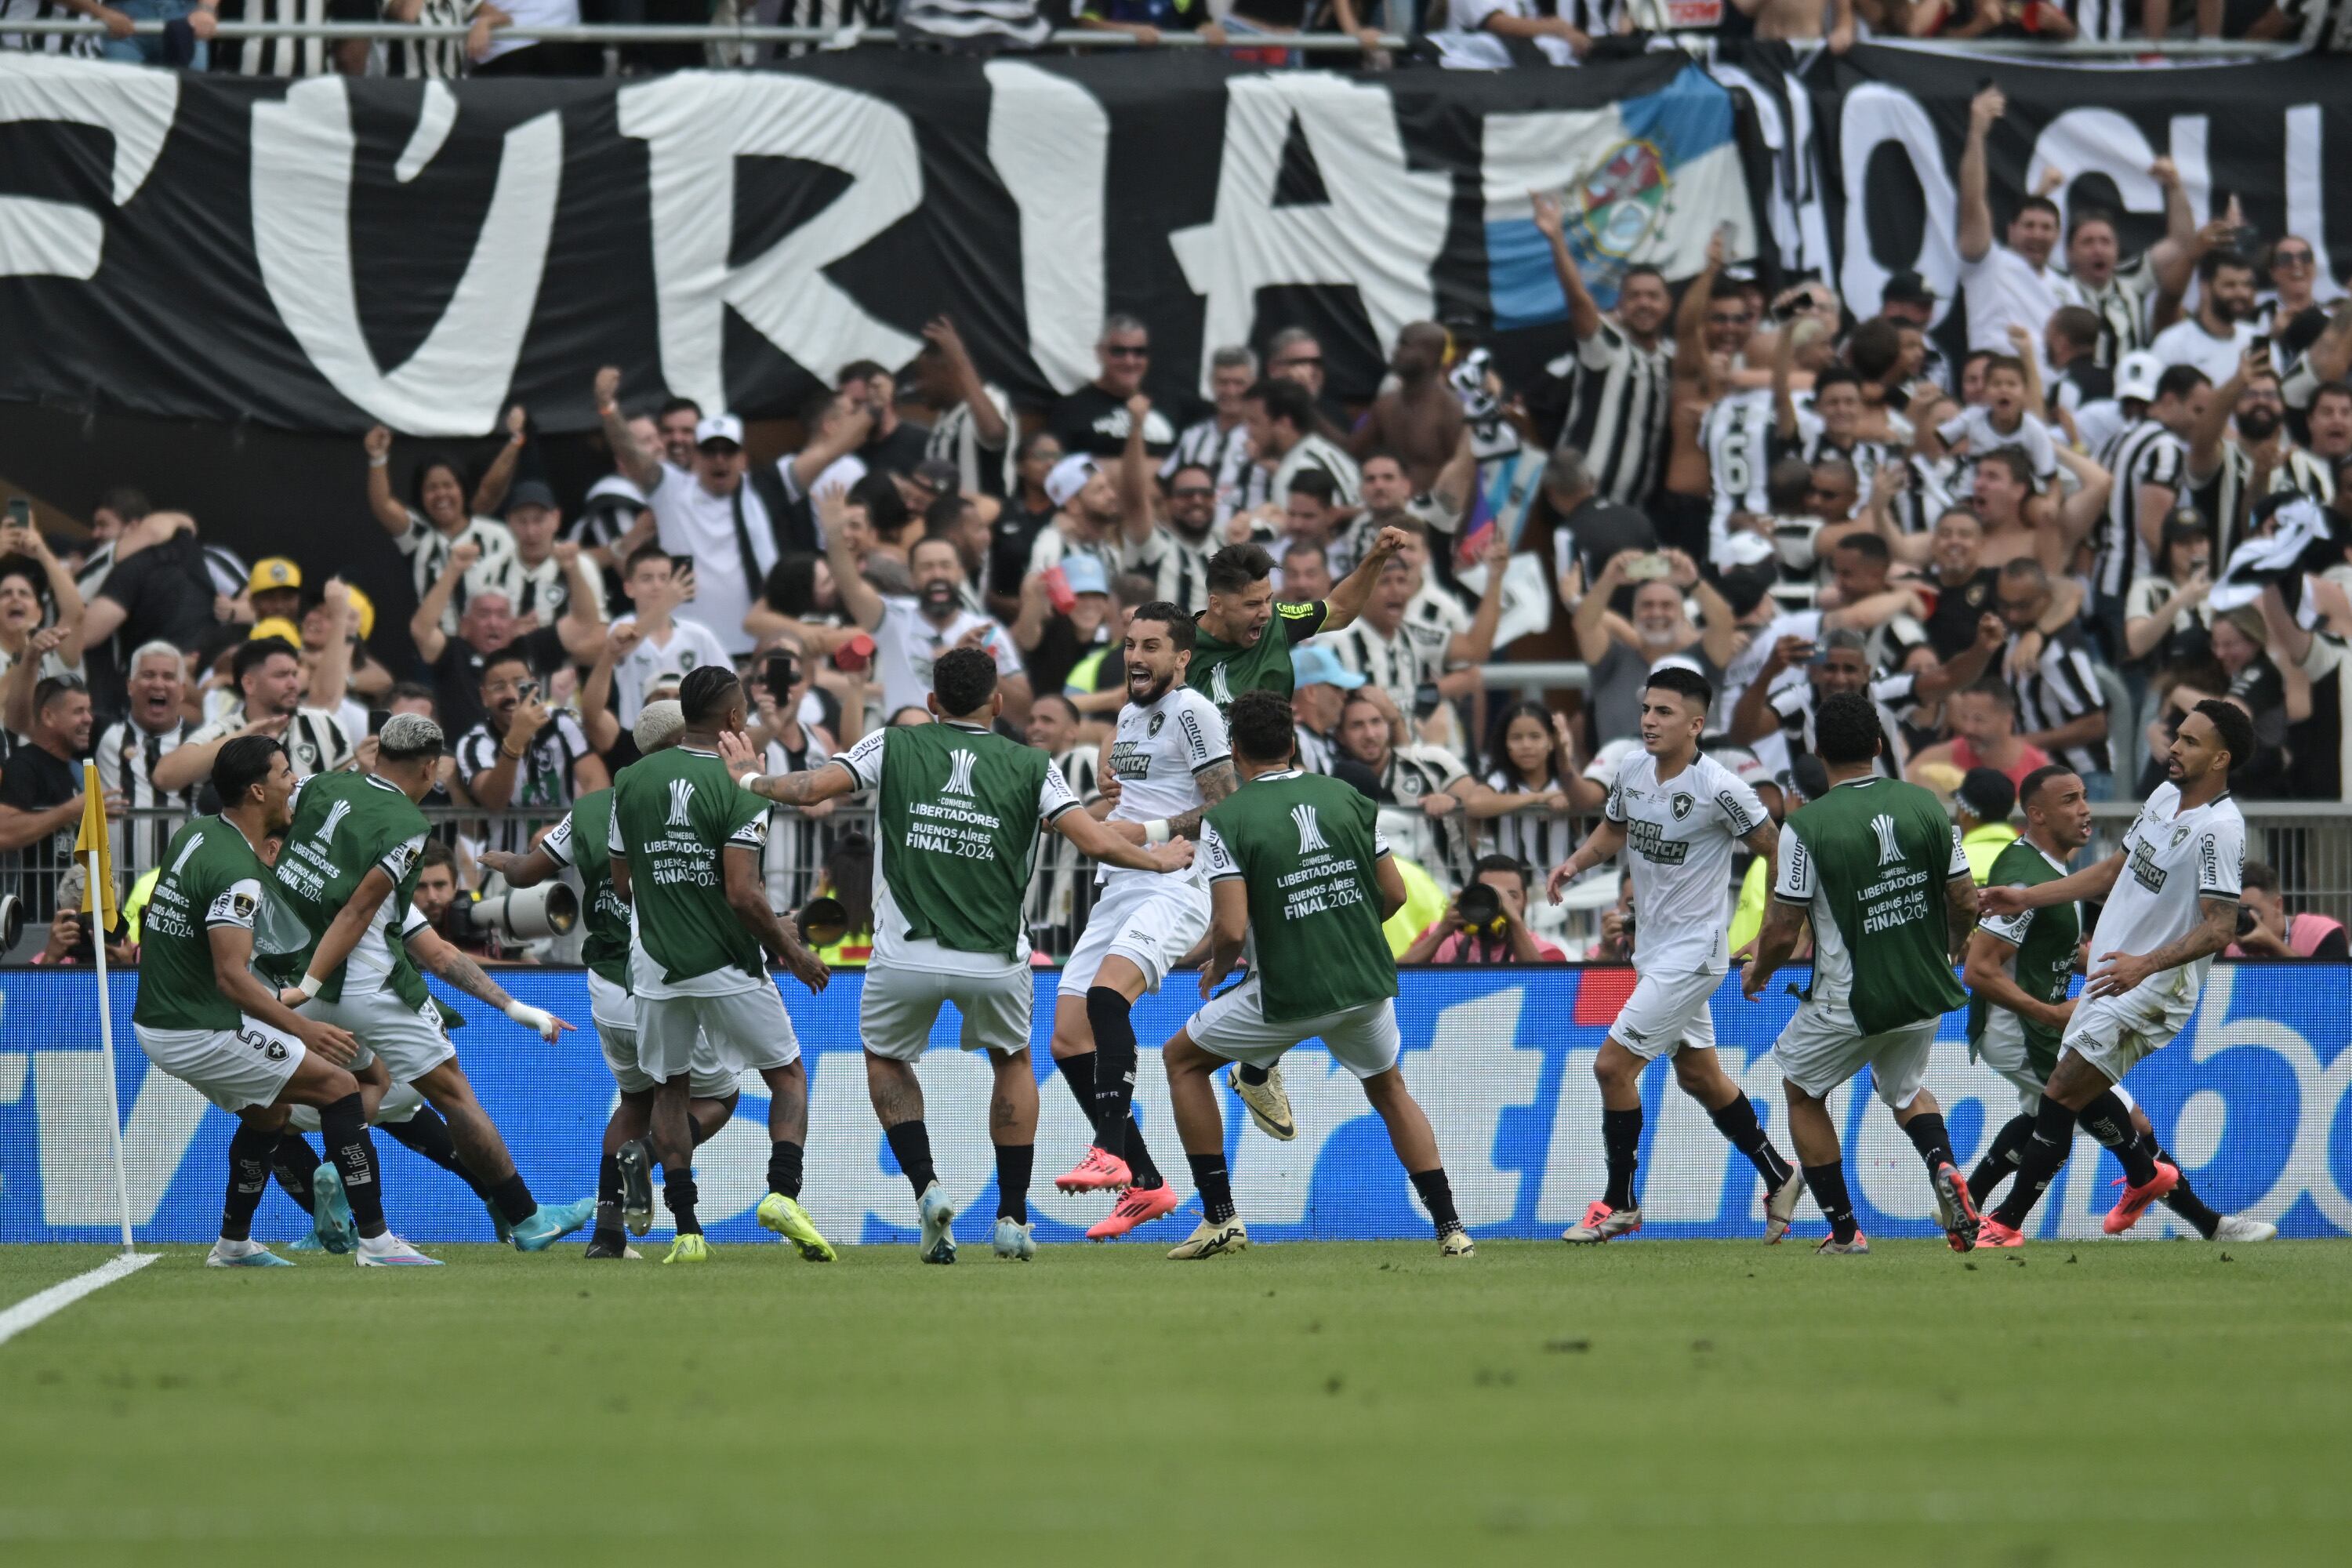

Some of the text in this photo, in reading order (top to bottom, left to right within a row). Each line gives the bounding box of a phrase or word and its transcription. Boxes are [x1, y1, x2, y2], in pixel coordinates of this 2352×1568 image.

[1719, 434, 1748, 495] 6
[1181, 709, 1207, 759] Centrum
[909, 802, 1000, 829] LIBERTADORES
[1719, 789, 1754, 831] Centrum
[912, 822, 992, 844] BUENOS AIRES
[1628, 818, 1661, 840] PARI
[644, 840, 716, 860] LIBERTADOES
[906, 833, 994, 862] FINAL 2024
[1628, 835, 1687, 858] MATCH
[2205, 833, 2216, 885] Centrum
[285, 858, 309, 878] BUENOS
[290, 840, 340, 879] LIBERTADORES
[689, 857, 710, 871] AIRE
[276, 866, 321, 905] FINAL 2024
[1288, 884, 1326, 903] BUENOS
[1283, 887, 1363, 920] FINAL 2024
[1904, 900, 1928, 921] 204
[162, 919, 194, 938] 2024
